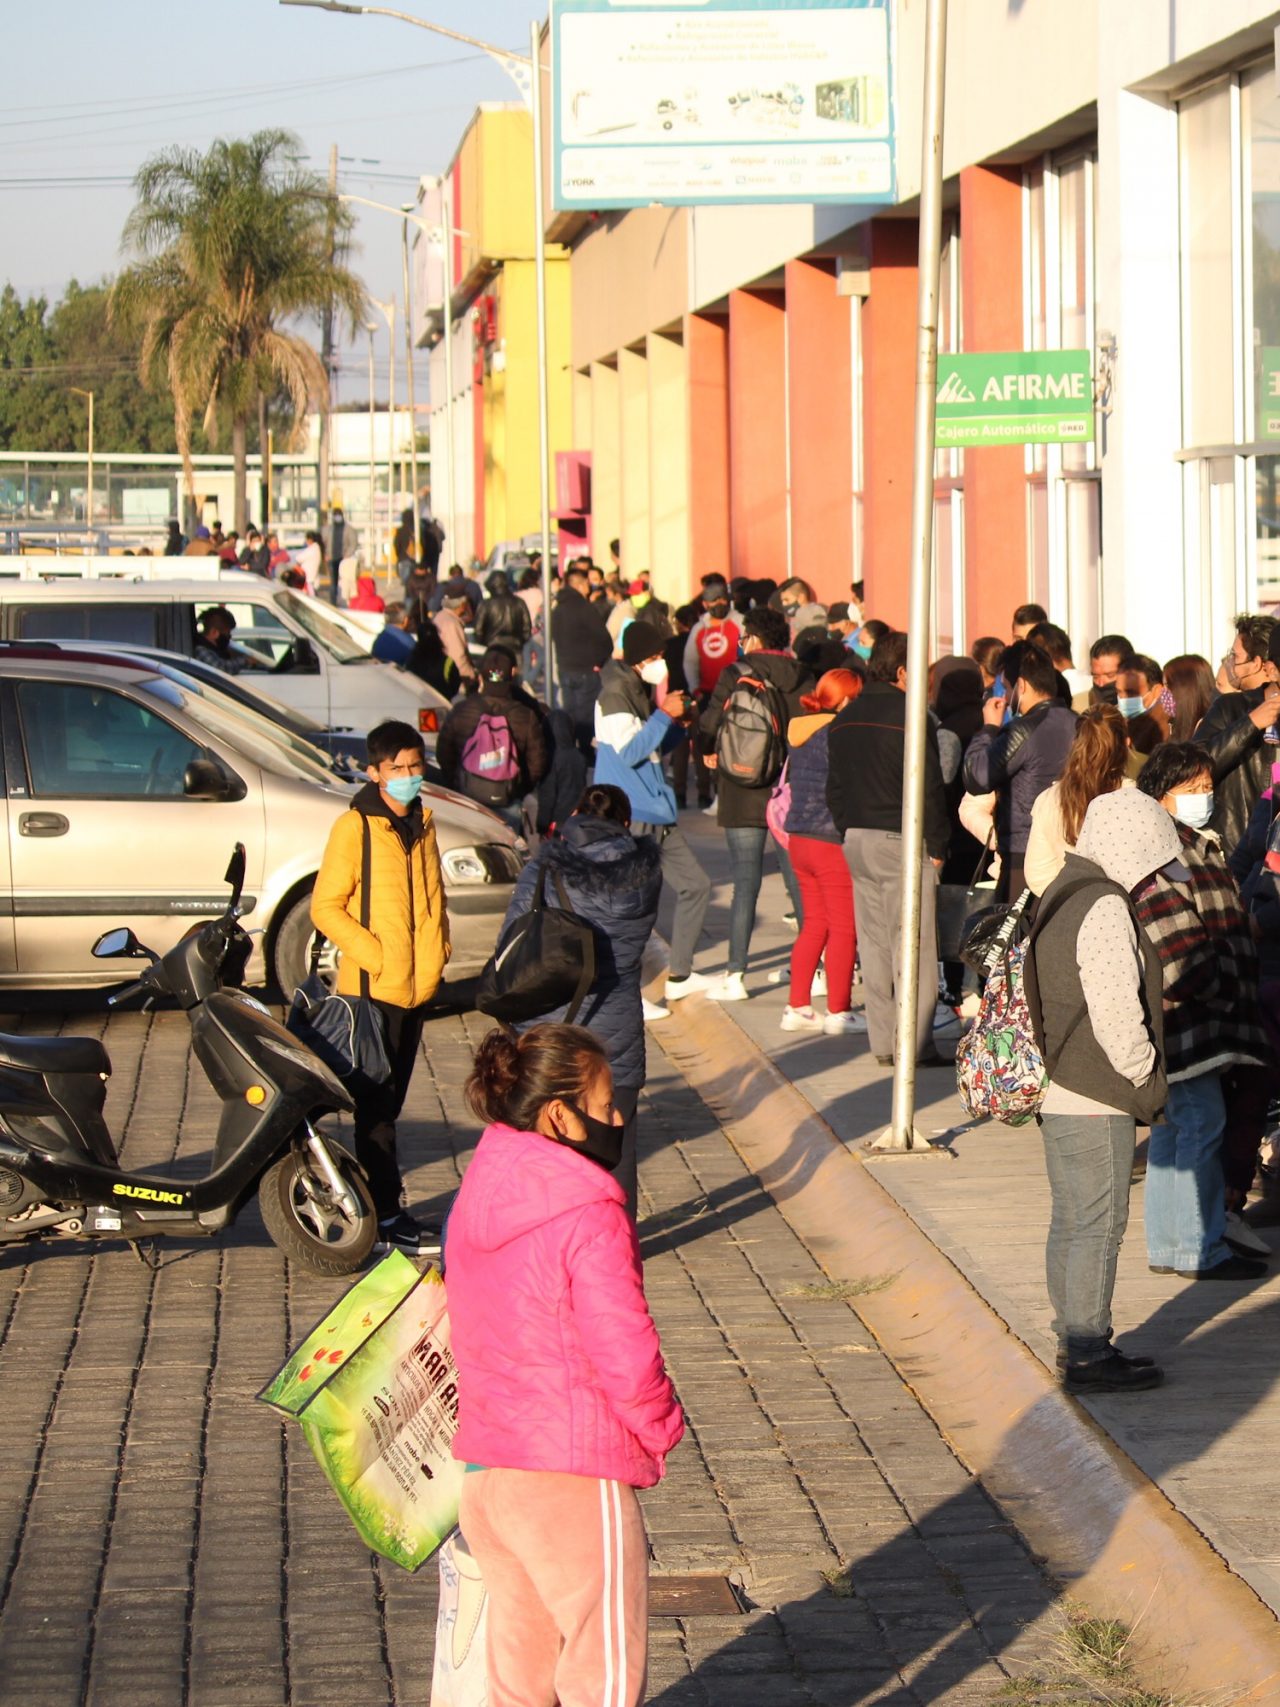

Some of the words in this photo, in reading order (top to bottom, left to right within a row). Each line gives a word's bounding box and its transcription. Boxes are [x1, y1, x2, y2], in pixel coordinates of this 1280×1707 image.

[571, 178, 595, 186] YORK
[982, 372, 1085, 402] AFIRME
[936, 425, 979, 440] Cajero
[981, 422, 1056, 437] Automático
[997, 916, 1017, 942] PINK
[983, 944, 1003, 969] PINK
[112, 1183, 184, 1205] SUZUKI
[380, 1386, 401, 1417] SONY
[403, 1440, 420, 1462] mabe
